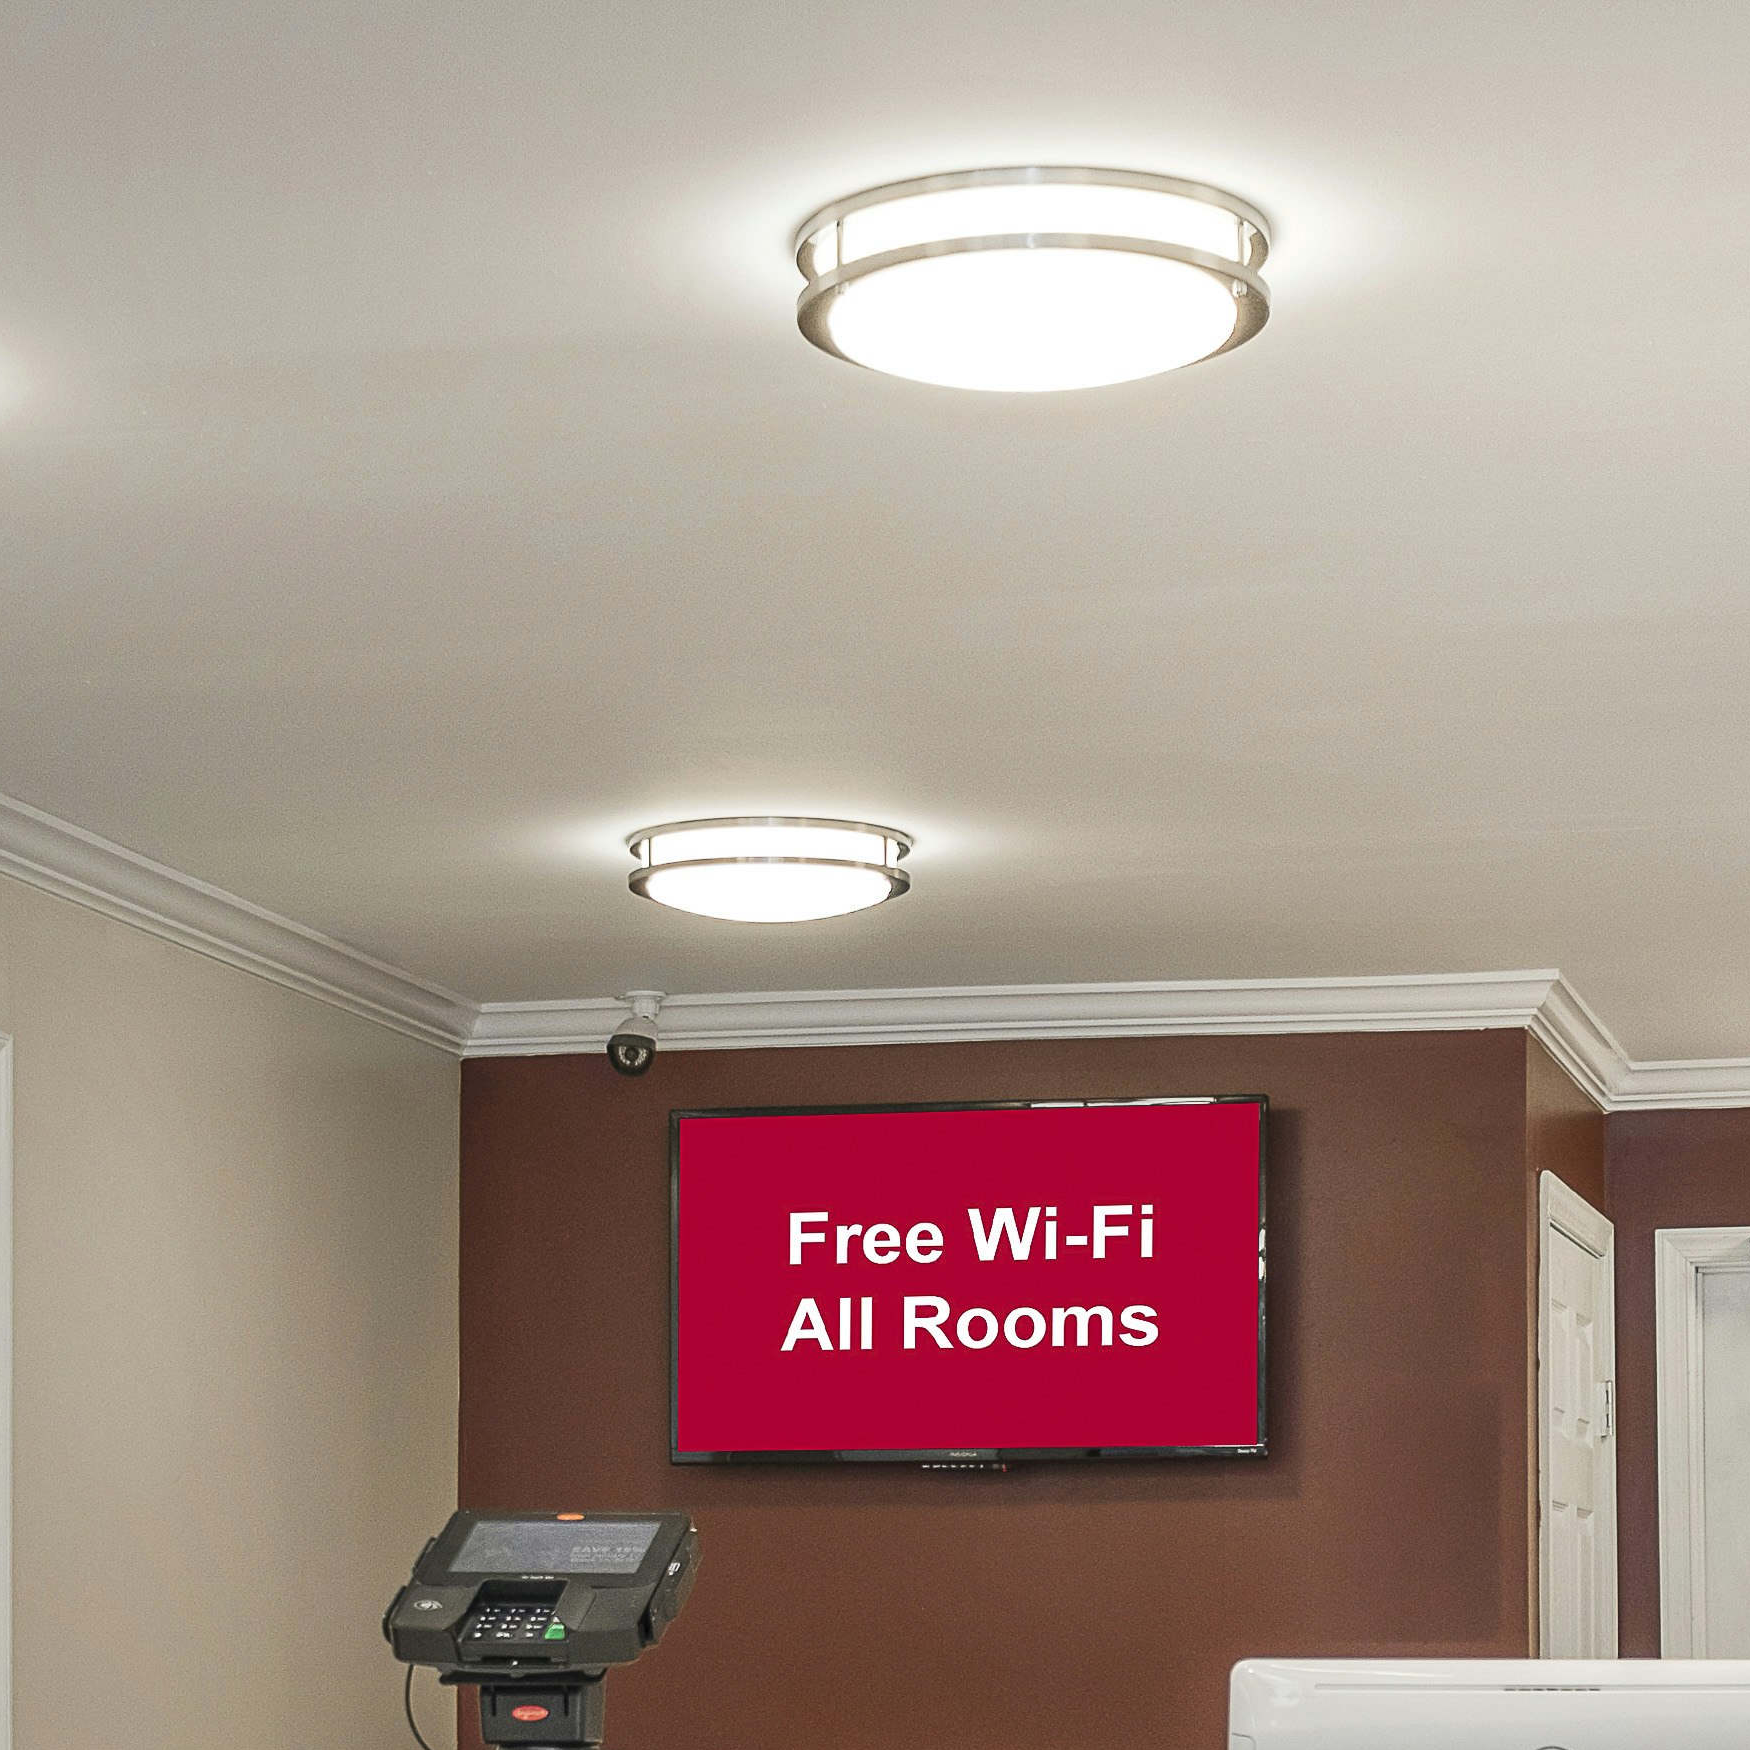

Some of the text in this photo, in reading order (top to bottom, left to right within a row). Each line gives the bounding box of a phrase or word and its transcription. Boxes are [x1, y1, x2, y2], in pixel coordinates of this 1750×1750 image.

[789, 1204, 1154, 1265] Free Wi-Fi
[780, 1295, 1159, 1352] All Rooms
